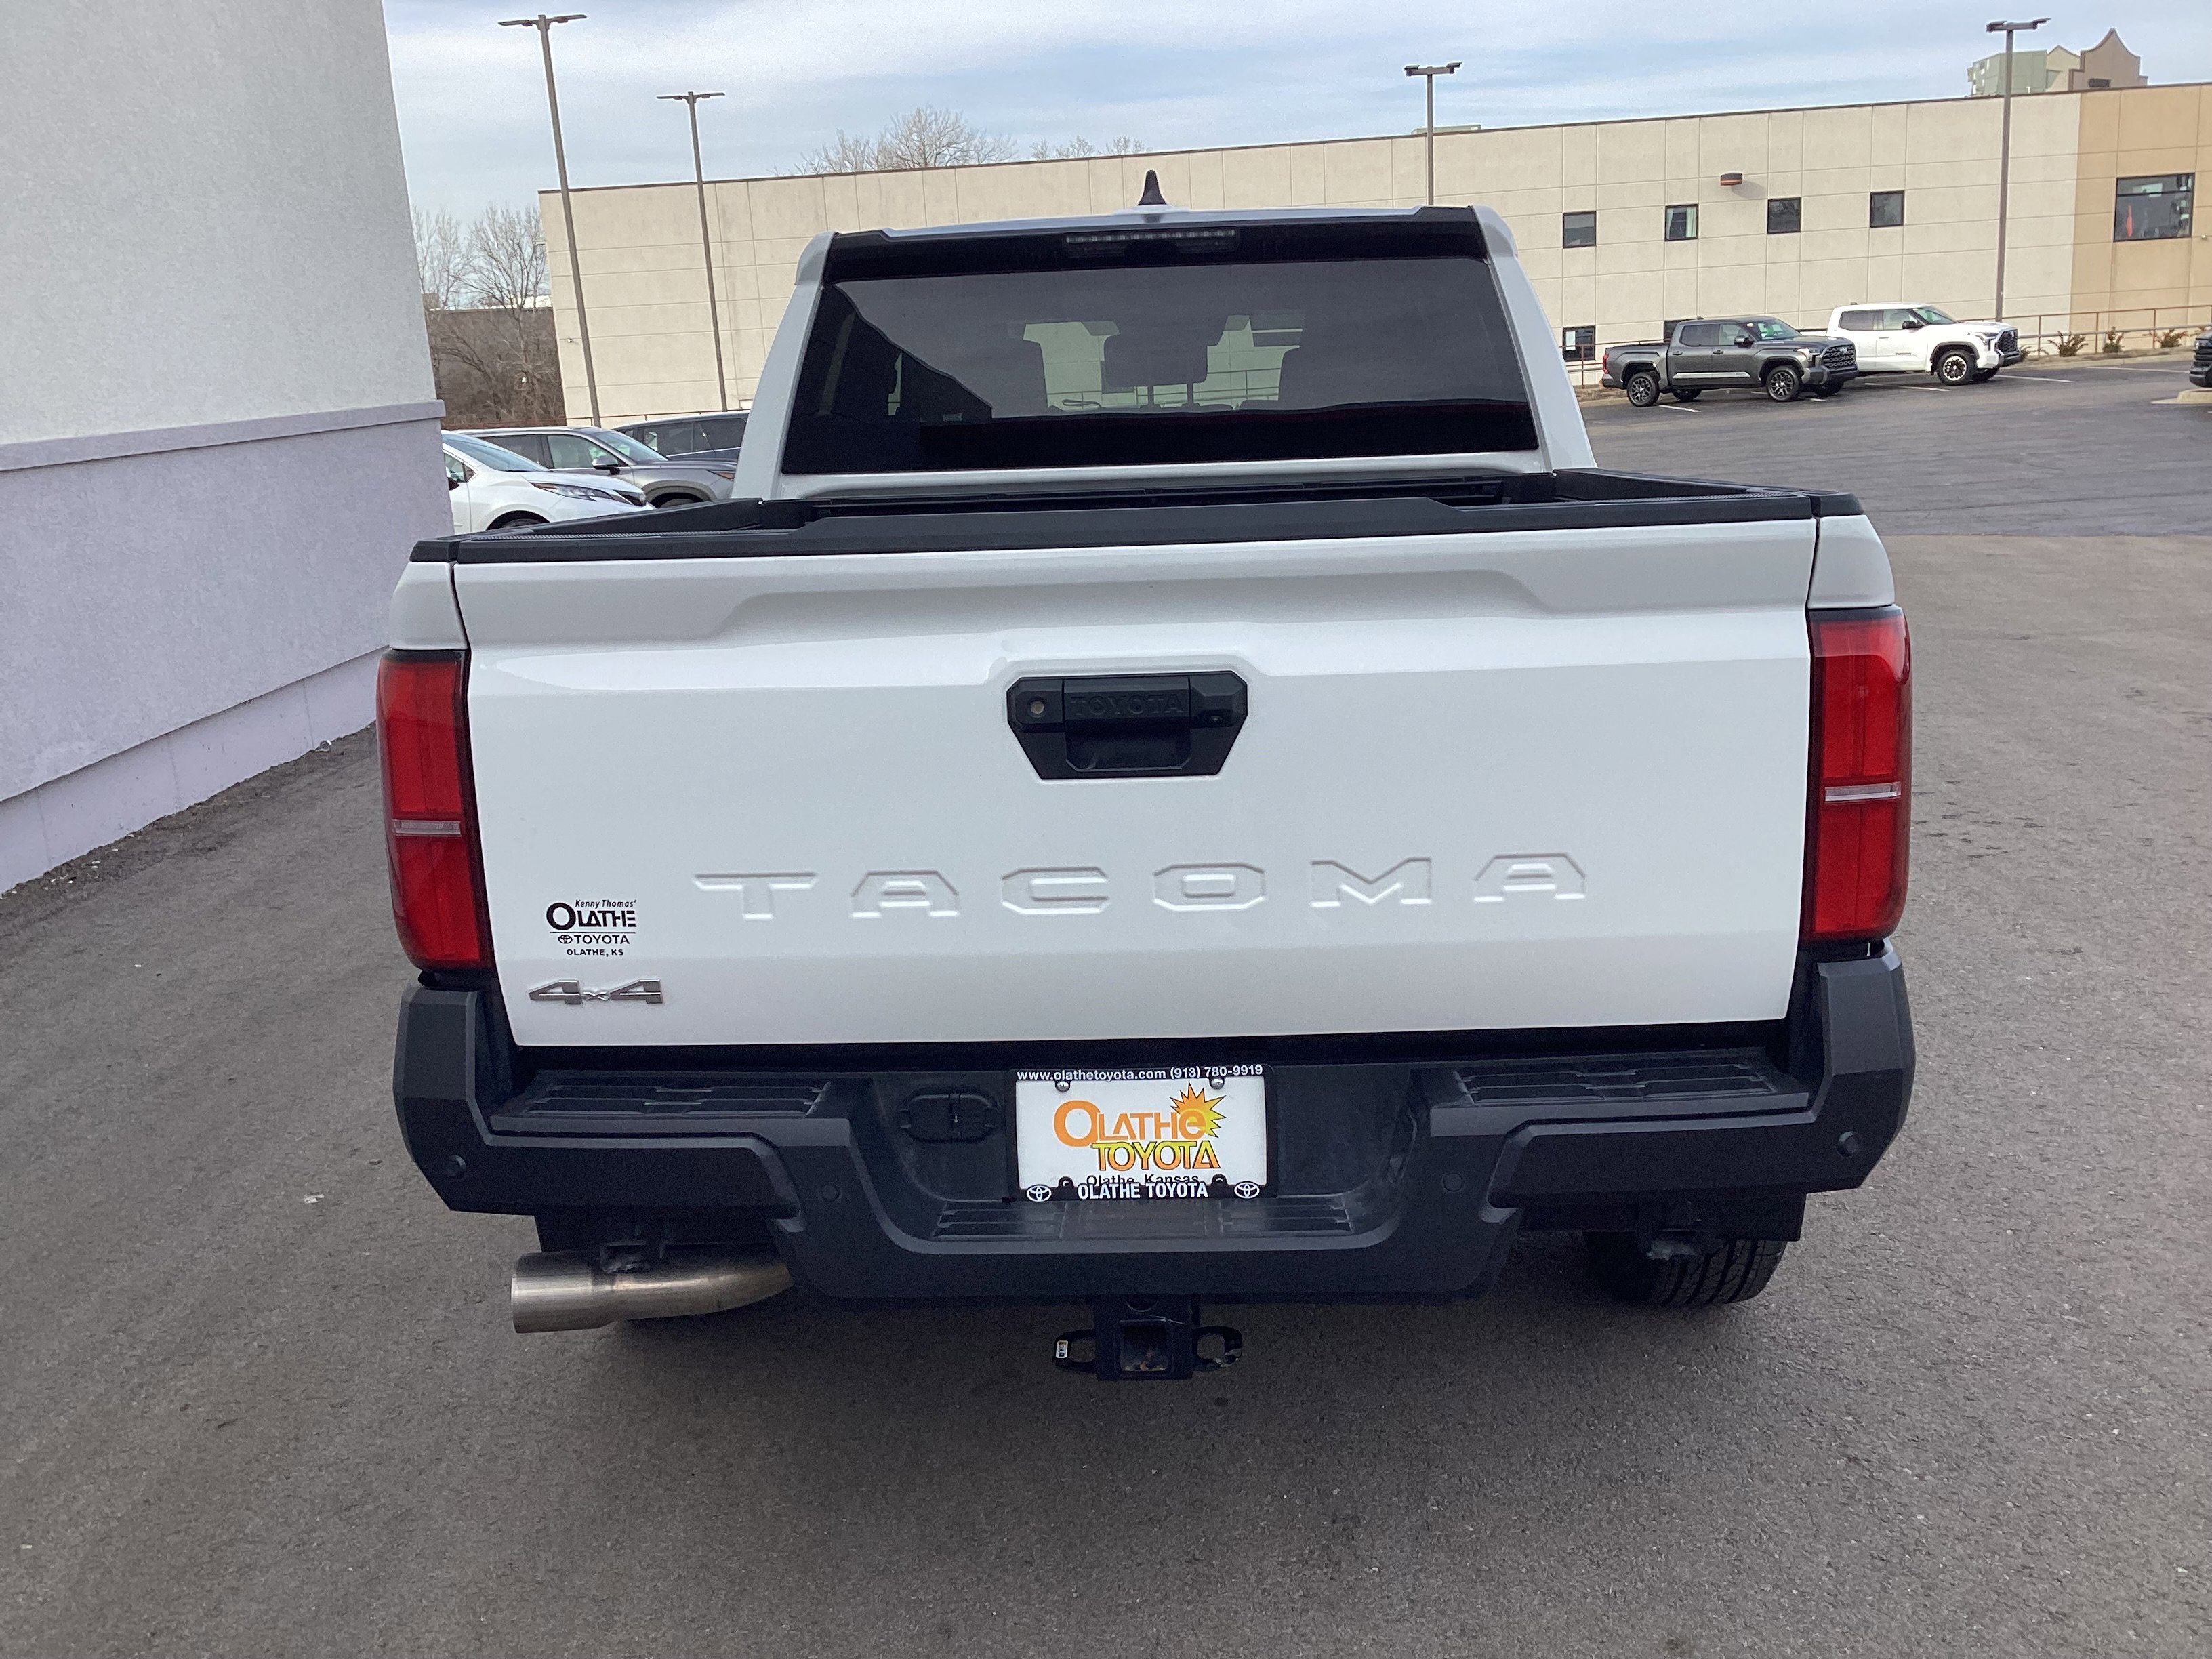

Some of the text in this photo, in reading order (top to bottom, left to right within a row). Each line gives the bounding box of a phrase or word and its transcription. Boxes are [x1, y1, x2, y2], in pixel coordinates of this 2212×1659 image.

[1070, 693, 1185, 716] TOYOTA
[693, 852, 1585, 920] TACOMA
[575, 899, 637, 909] Kenny Thomas'
[546, 902, 636, 931] OLATHE
[574, 935, 630, 945] TOYOTA
[567, 949, 609, 957] OLATHE,
[1017, 1064, 1263, 1082] www.olathetoyota.com (913) 780-9919
[1091, 1140, 1221, 1172] TOYOTA
[1145, 1173, 1200, 1184] Kansas
[1078, 1181, 1209, 1200] OLATHE TOYOTA
